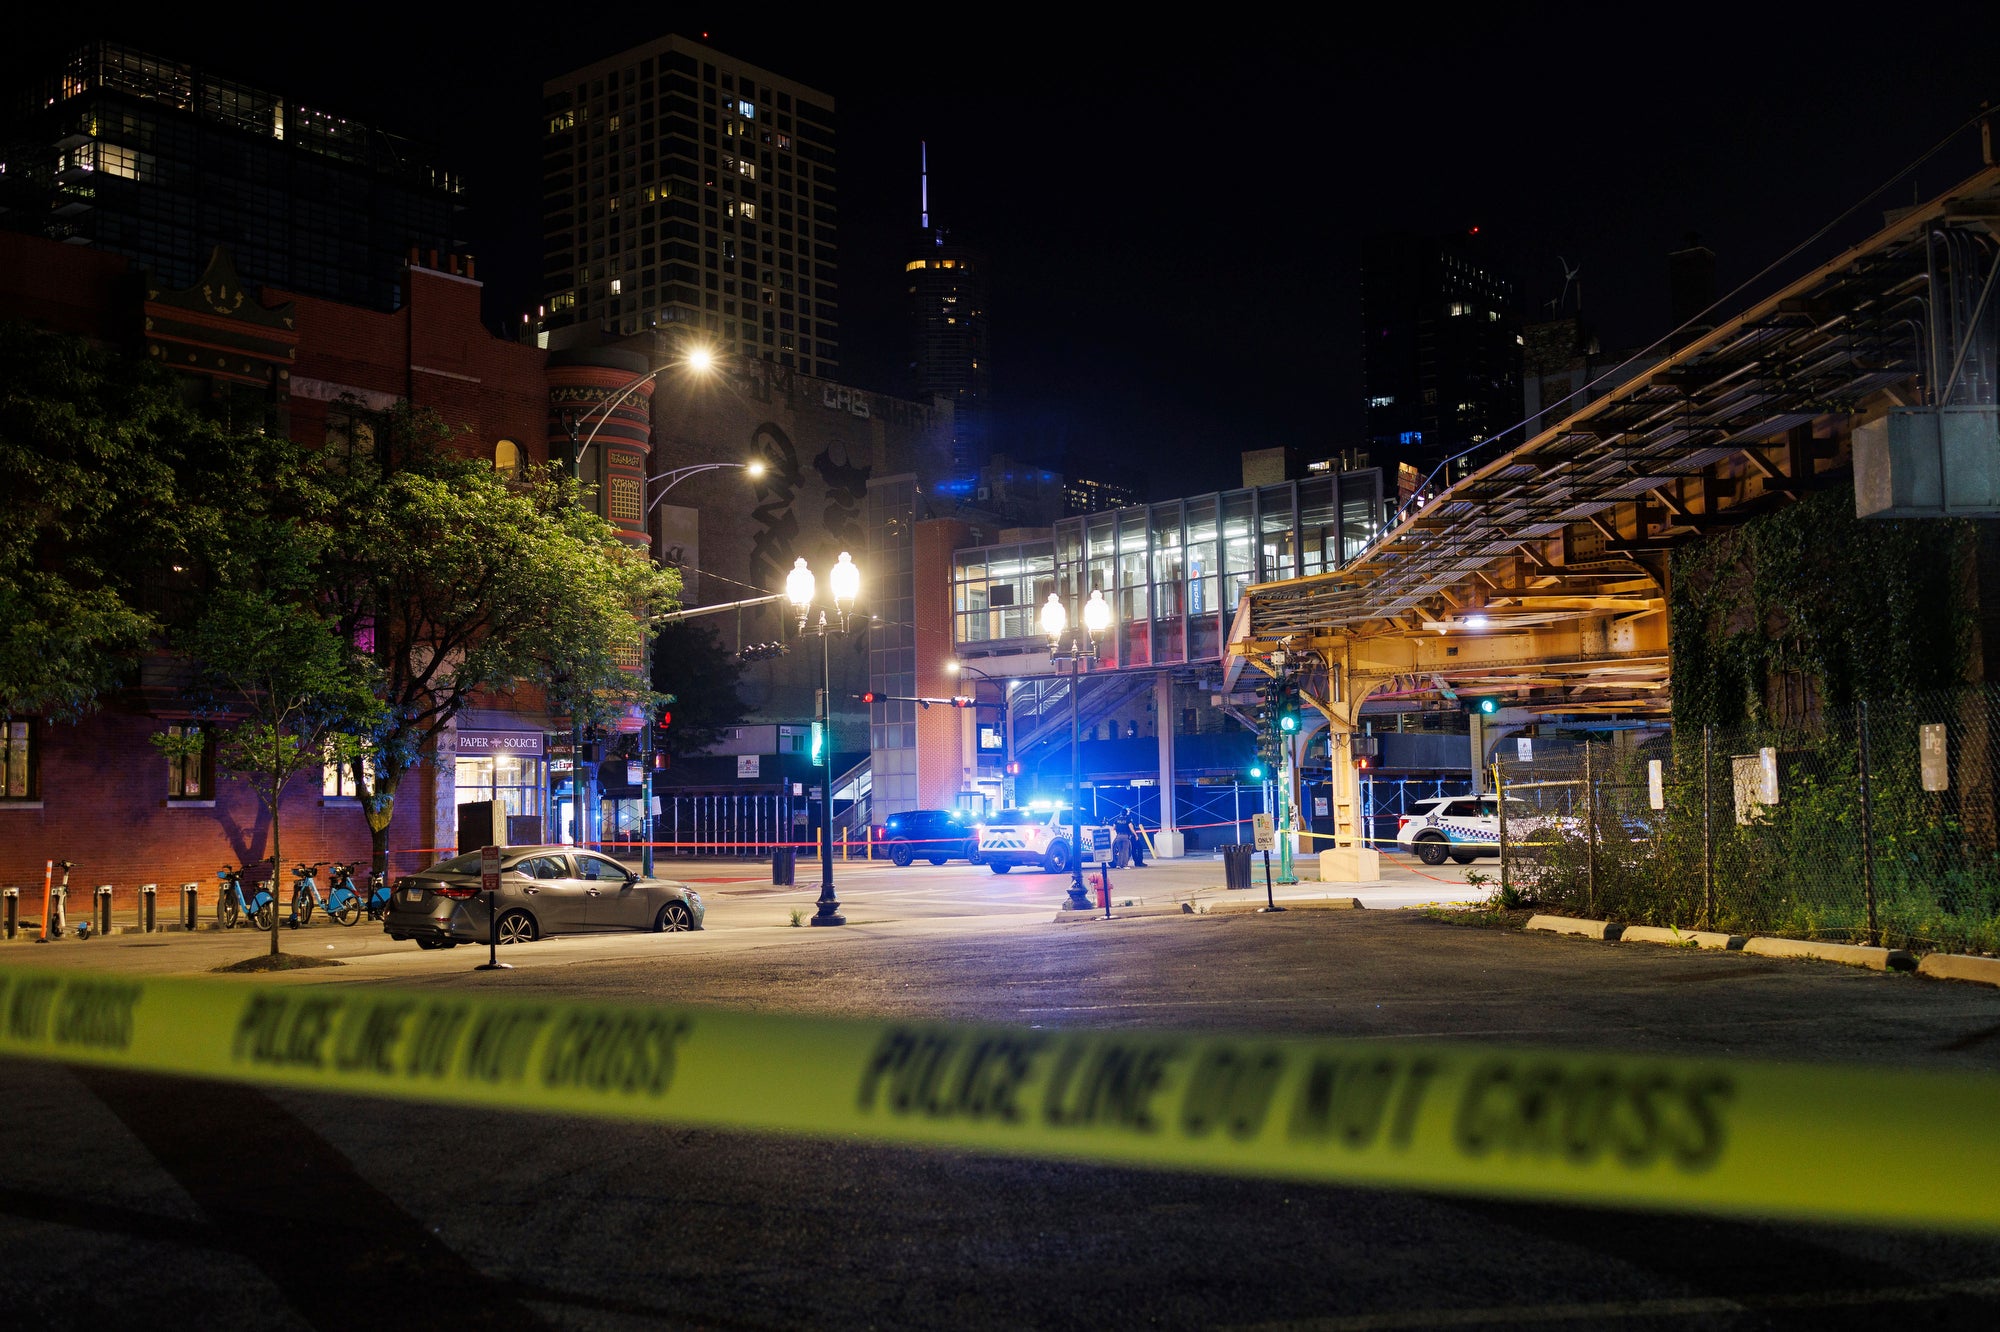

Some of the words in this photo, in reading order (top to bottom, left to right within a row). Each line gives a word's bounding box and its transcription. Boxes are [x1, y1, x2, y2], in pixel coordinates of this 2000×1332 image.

[460, 737, 489, 748] PAPER
[504, 738, 538, 748] SOURCE
[232, 990, 342, 1066] POLICE
[335, 998, 415, 1075] LINE
[408, 1000, 471, 1078] DO
[465, 1007, 549, 1083] NOT
[540, 1008, 694, 1096] CROSS
[857, 1026, 1048, 1125] POLICE
[1042, 1032, 1181, 1136] LINE
[1176, 1040, 1287, 1142] DO
[1286, 1050, 1442, 1151] NOT
[1454, 1056, 1737, 1175] CROSS
